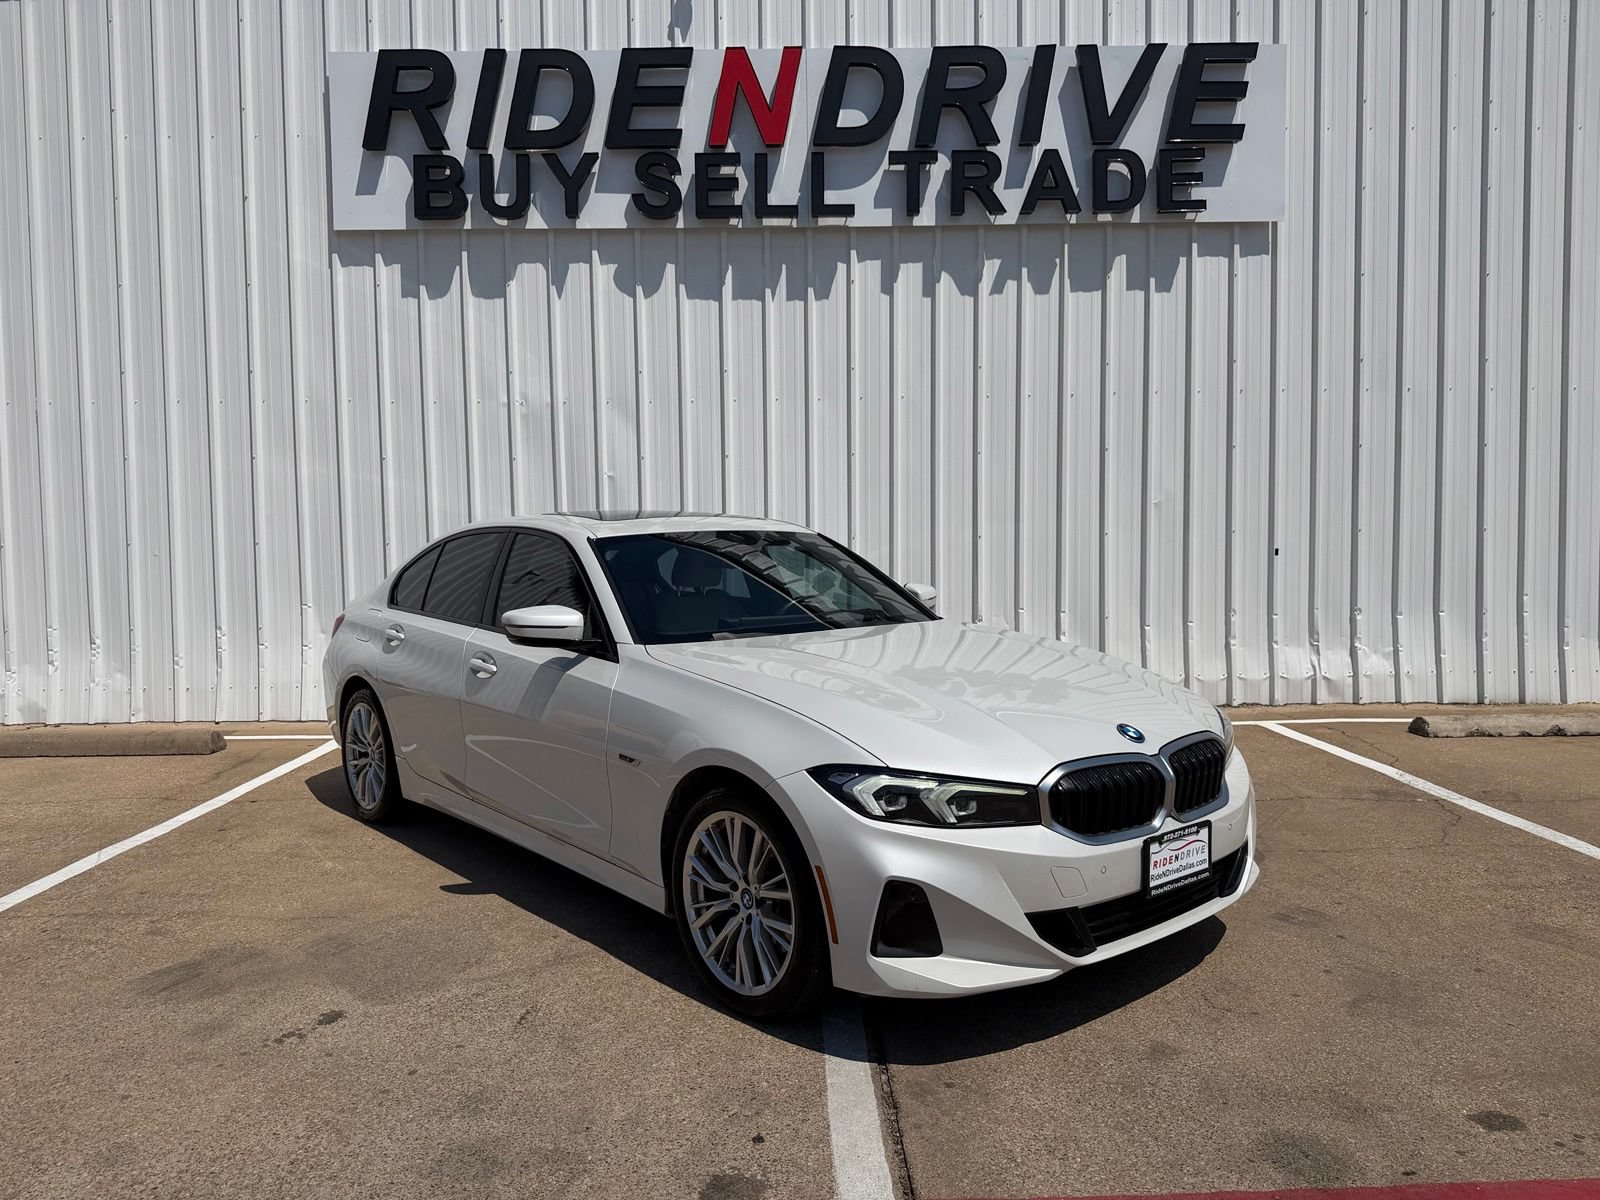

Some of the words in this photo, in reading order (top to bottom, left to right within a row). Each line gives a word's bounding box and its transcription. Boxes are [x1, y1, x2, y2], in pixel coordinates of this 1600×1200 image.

[362, 42, 1259, 151] RIDENDRIVE
[412, 152, 599, 220] BUY
[631, 150, 855, 219] SELL
[888, 147, 1207, 215] TRADE
[1152, 844, 1206, 870] RIDENDRIVE
[1151, 858, 1208, 883] RideNDriveDallas.com
[1151, 871, 1210, 896] RideNDriveDallas.com
